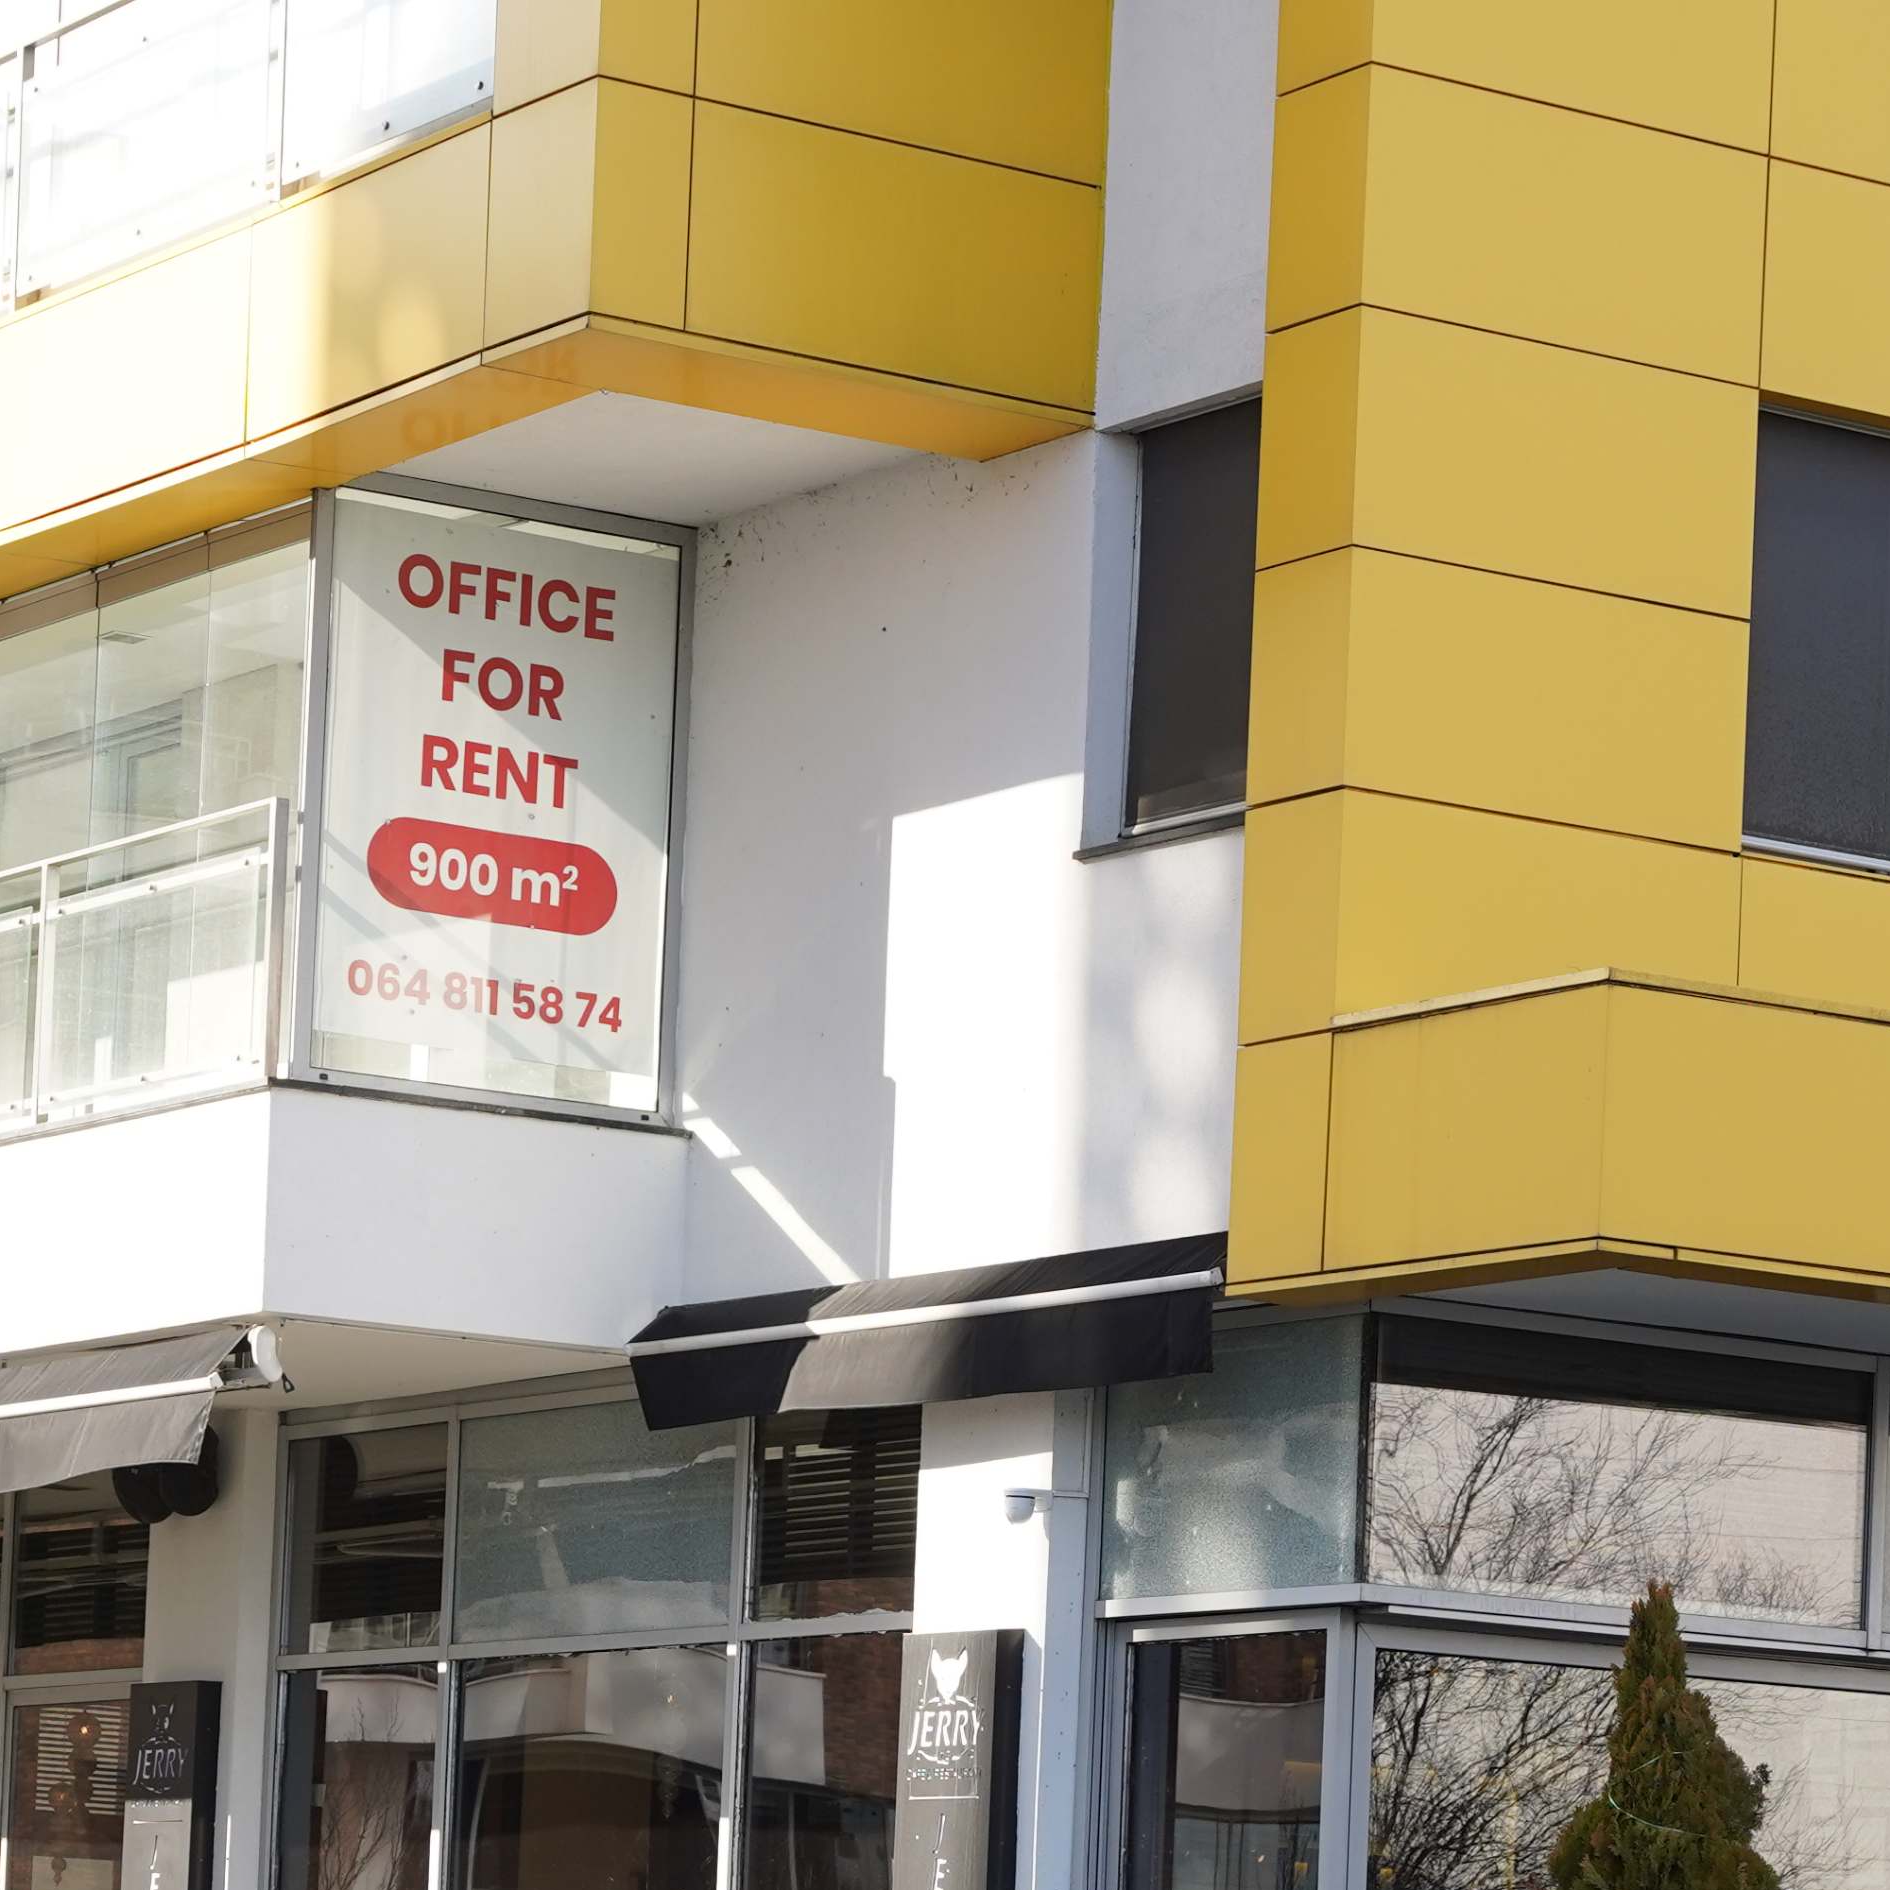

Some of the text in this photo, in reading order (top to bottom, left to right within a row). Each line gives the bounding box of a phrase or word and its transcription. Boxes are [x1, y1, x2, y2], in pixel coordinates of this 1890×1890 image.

[397, 552, 617, 643] OFFICE
[440, 647, 565, 722] FOR
[419, 733, 579, 810] RENT
[408, 842, 499, 897] 900
[346, 959, 623, 1034] 064 811 58 74
[131, 1747, 189, 1786] JERRY
[906, 1708, 984, 1756] JERRY
